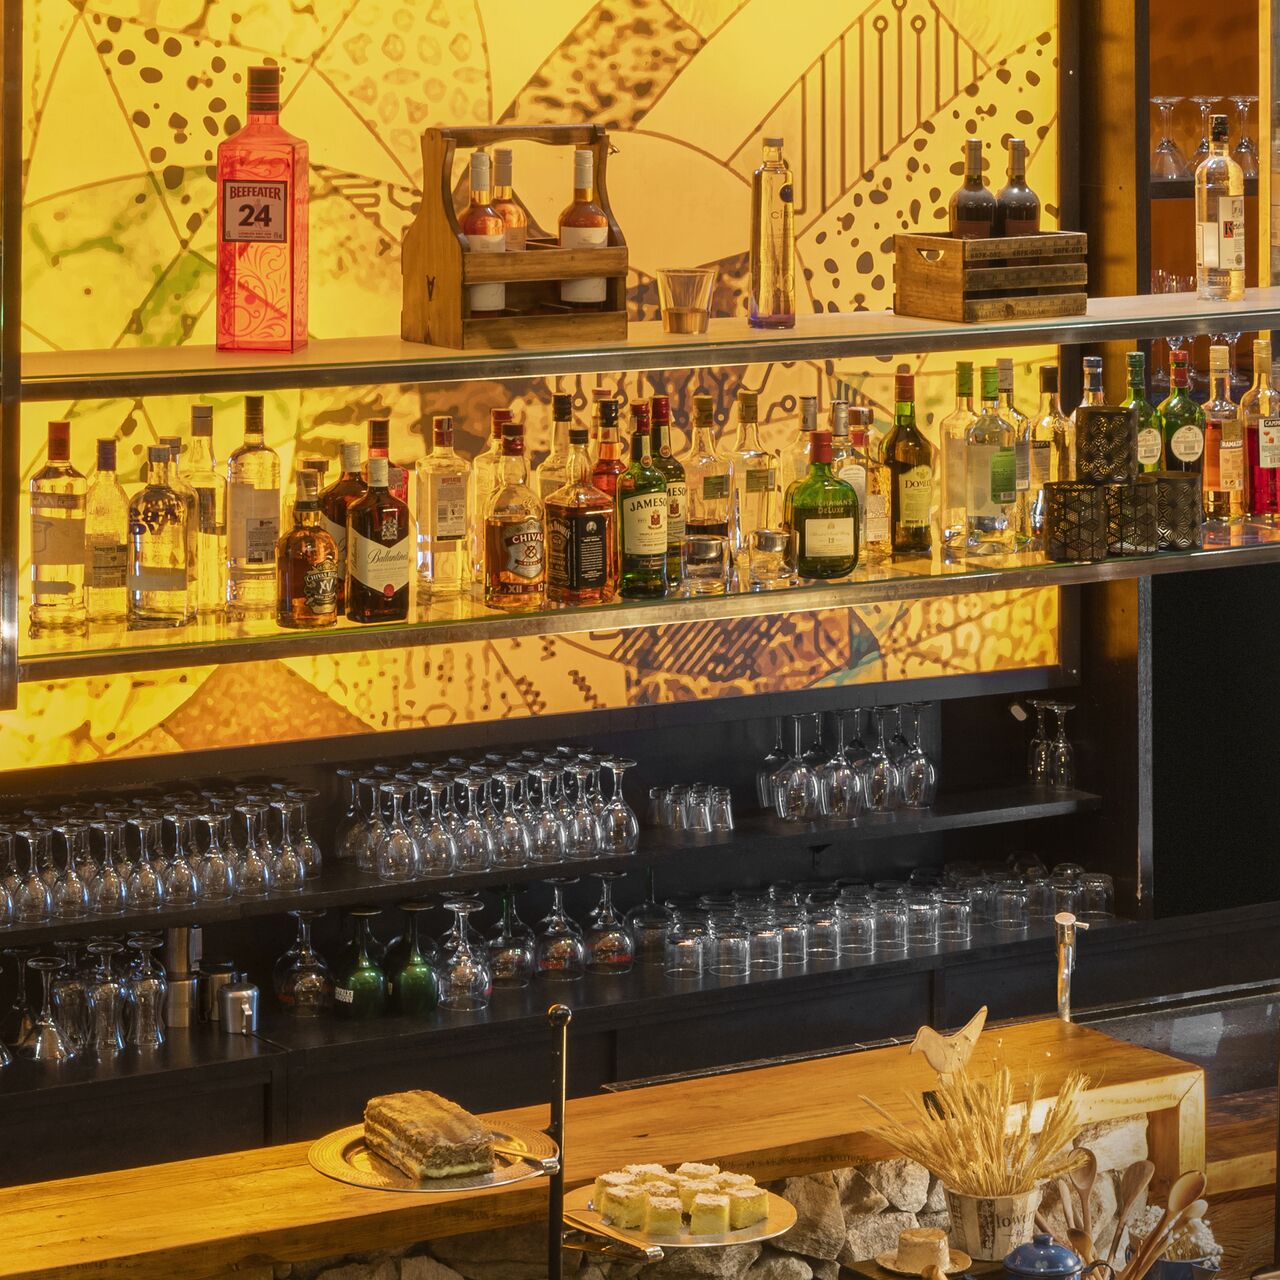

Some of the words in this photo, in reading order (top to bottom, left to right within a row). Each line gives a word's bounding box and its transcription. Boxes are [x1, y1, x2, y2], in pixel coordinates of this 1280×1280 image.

[230, 186, 281, 200] BEEFEATER
[238, 204, 272, 227] 24
[320, 579, 333, 593] XV
